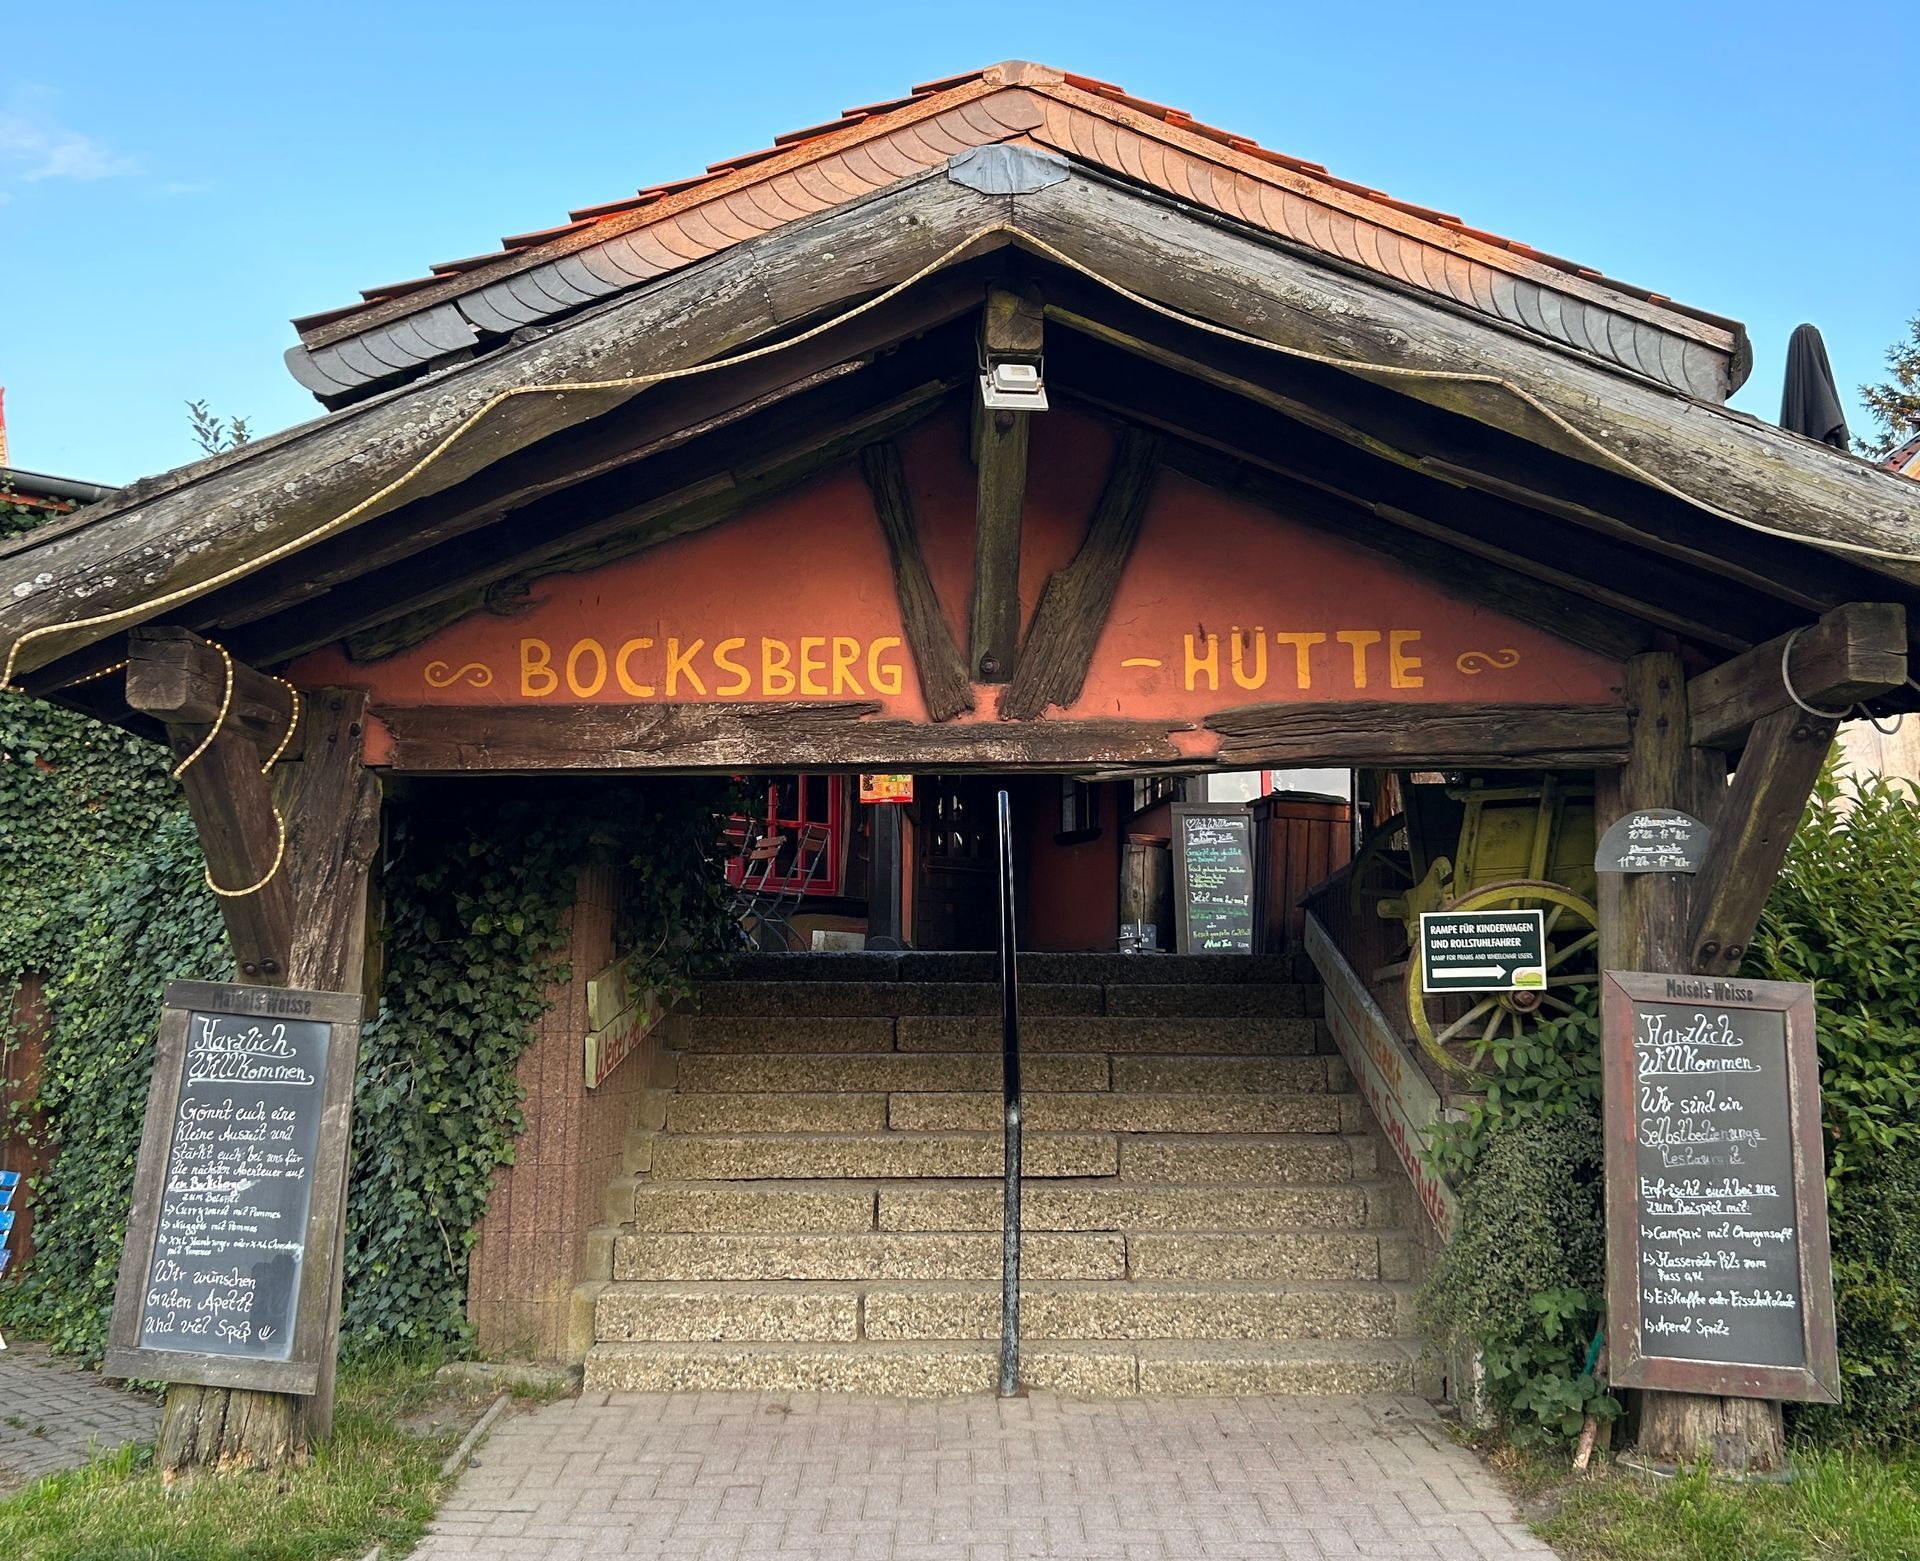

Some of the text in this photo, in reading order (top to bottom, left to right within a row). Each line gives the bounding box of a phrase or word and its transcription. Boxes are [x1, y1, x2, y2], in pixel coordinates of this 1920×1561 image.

[520, 636, 903, 698] BOCKSBERG
[1184, 625, 1425, 691] HÜTTE
[1430, 922, 1534, 935] RAMPE FÜR KINDERWAGEN
[1431, 937, 1522, 949] UND ROLLSTUHLFAHRER
[1518, 952, 1534, 960] USERS
[1713, 982, 1754, 1001] Weisse
[180, 1097, 296, 1121] Gönnt euch eine
[1641, 1086, 1743, 1114] Wir sind ein
[218, 1122, 267, 1141] Auszeit
[270, 1125, 295, 1141] und
[217, 1147, 241, 1162] euch
[247, 1145, 264, 1162] bei
[266, 1153, 284, 1163] uns
[285, 1148, 304, 1166] für
[171, 1160, 188, 1175] die
[191, 1160, 231, 1175] nächsten
[285, 1167, 305, 1180] auf
[1706, 1178, 1732, 1197] euch
[1732, 1178, 1753, 1196] bei
[1756, 1184, 1777, 1196] uns
[233, 1206, 249, 1216] mit
[249, 1206, 281, 1219] Pommes
[211, 1220, 227, 1231] mit
[228, 1220, 258, 1233] Pommes
[1653, 1225, 1702, 1247] Campari
[1707, 1221, 1730, 1240] mit
[1717, 1250, 1741, 1270] Pils
[1743, 1259, 1767, 1269] vom
[155, 1260, 256, 1290] Wir wünschen
[1658, 1268, 1681, 1283] Fass
[146, 1288, 254, 1317] Guten Apetit
[1708, 1290, 1730, 1306] oder
[180, 1315, 212, 1334] viel
[215, 1319, 251, 1344] Spaß
[1696, 1318, 1730, 1339] Spritz
